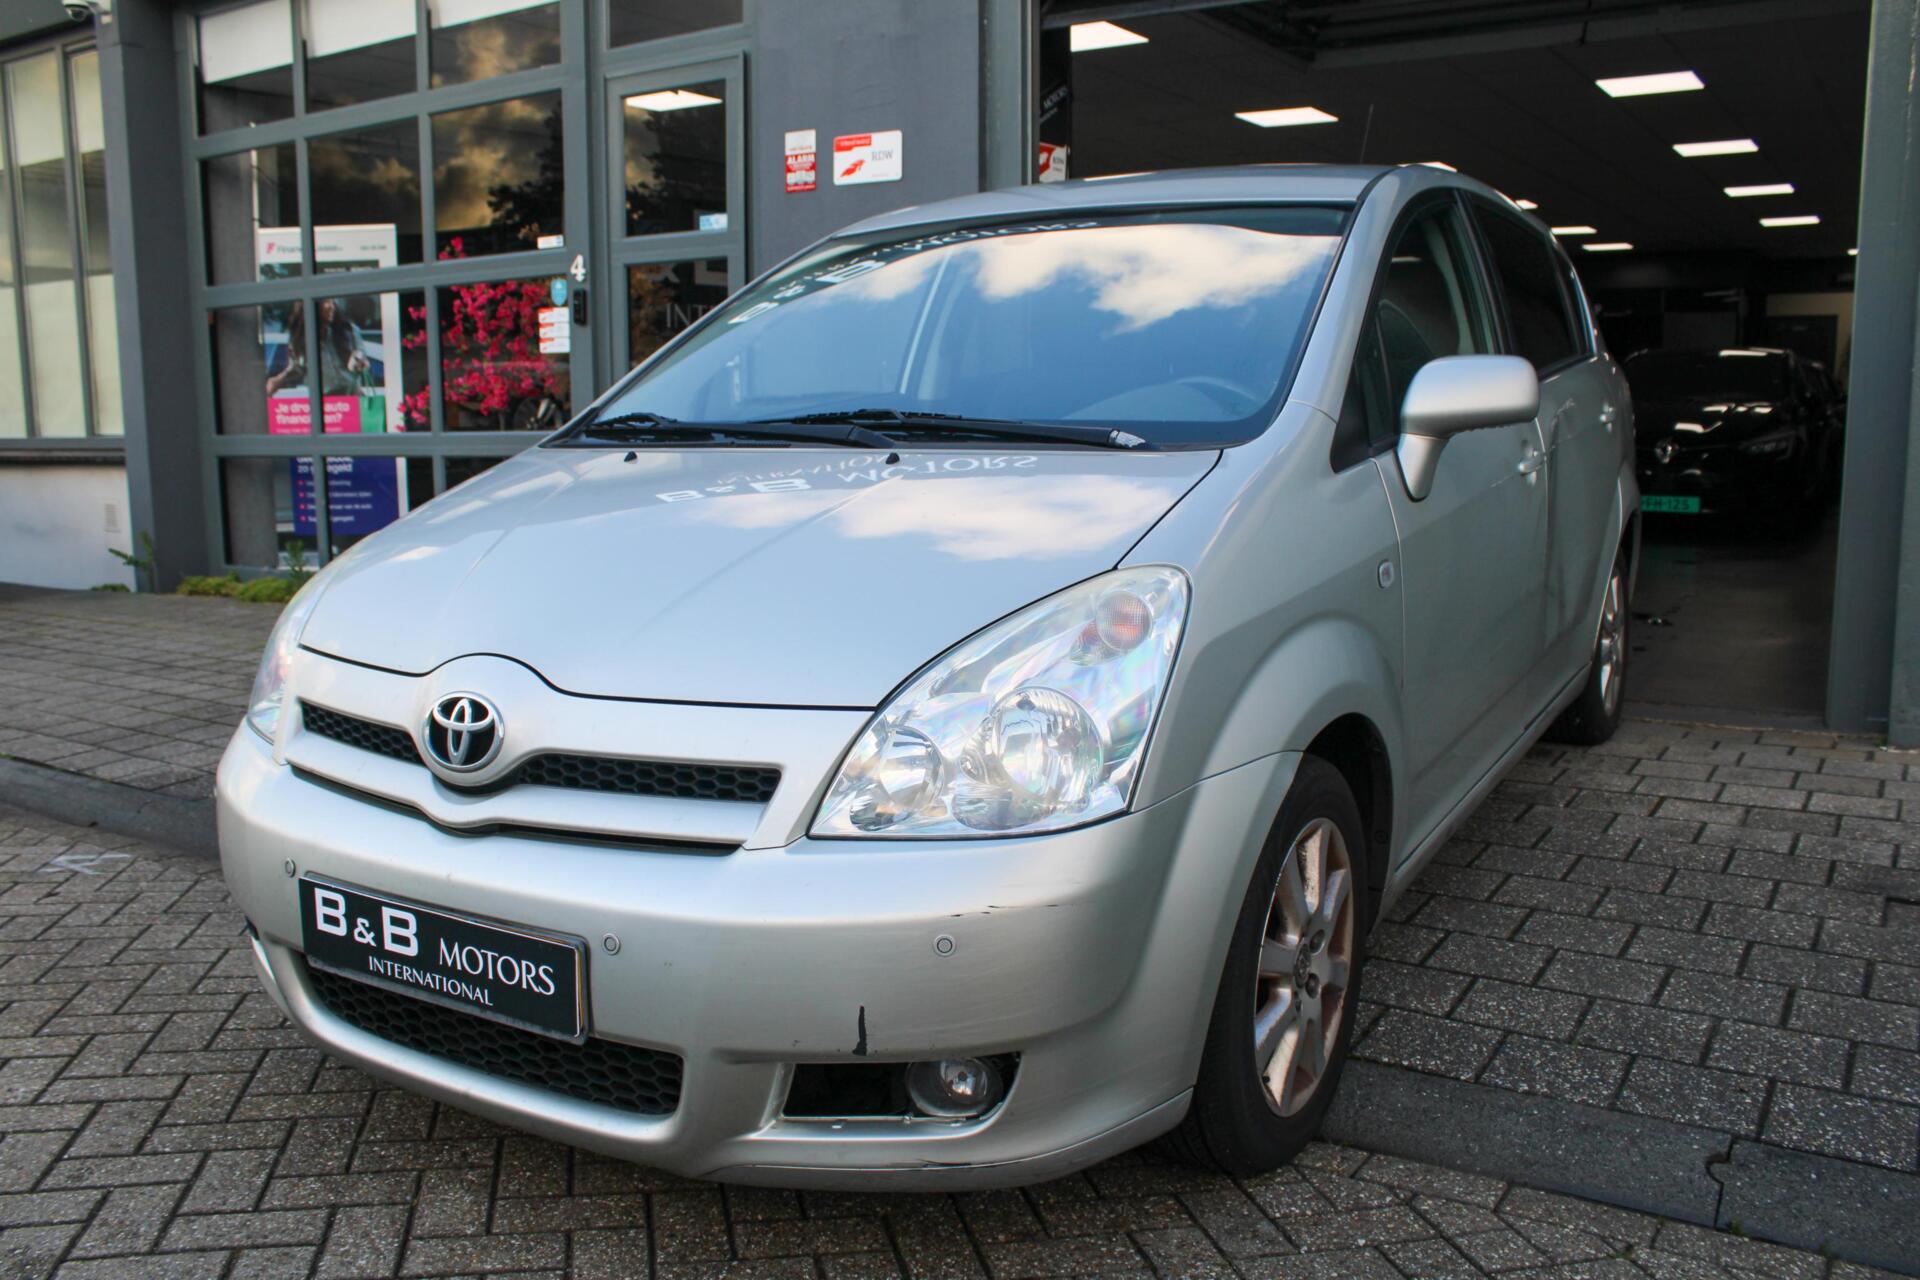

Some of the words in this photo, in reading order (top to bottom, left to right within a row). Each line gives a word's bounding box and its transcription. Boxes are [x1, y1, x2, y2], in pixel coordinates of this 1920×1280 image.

[872, 149, 894, 161] RDW
[570, 254, 586, 282] 4
[275, 402, 288, 414] Je
[439, 937, 556, 996] MOTORS
[369, 956, 494, 1006] INTERNATIONAL
